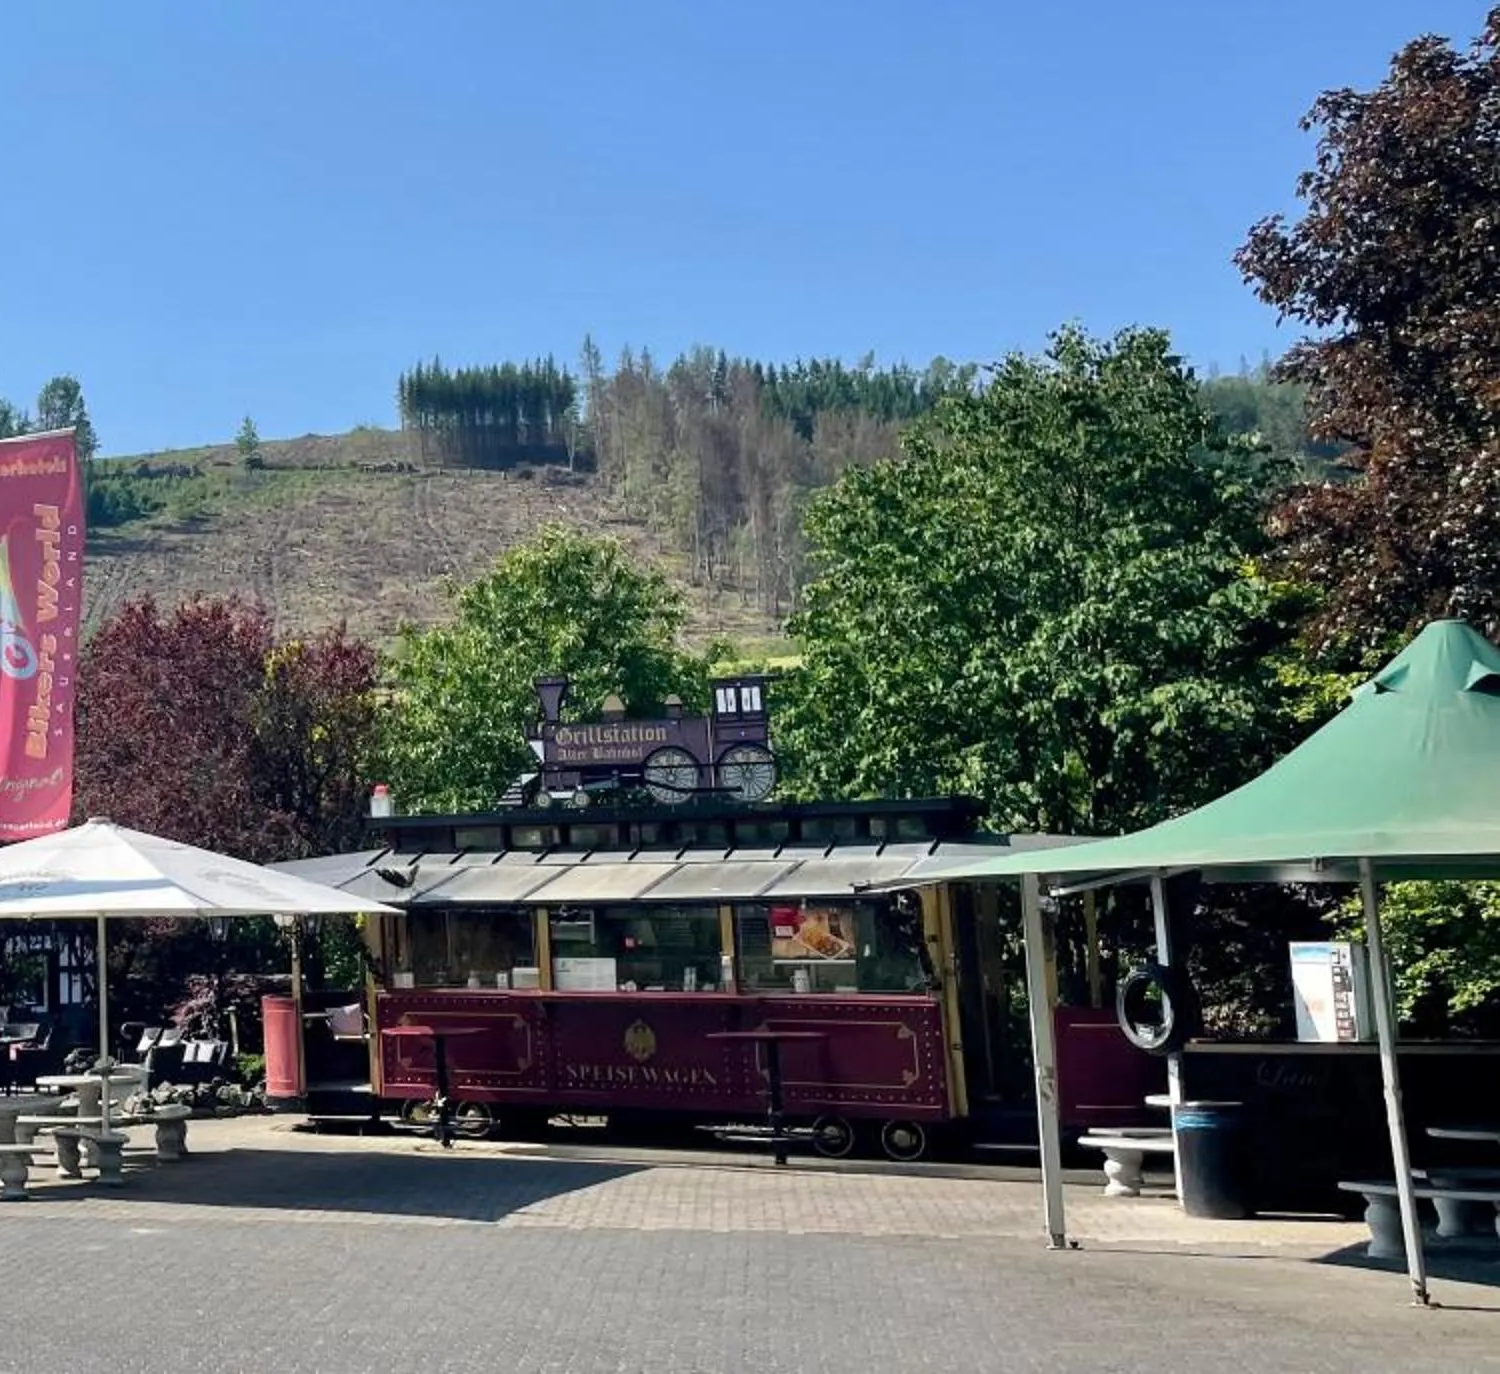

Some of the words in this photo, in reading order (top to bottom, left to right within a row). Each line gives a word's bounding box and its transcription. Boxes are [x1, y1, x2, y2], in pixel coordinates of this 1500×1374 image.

[33, 503, 61, 623] World
[53, 524, 78, 737] SAUERLAND
[25, 633, 57, 760] Bikers
[555, 726, 668, 746] Grillstation
[566, 1064, 718, 1086] SPEISEWAGEN
